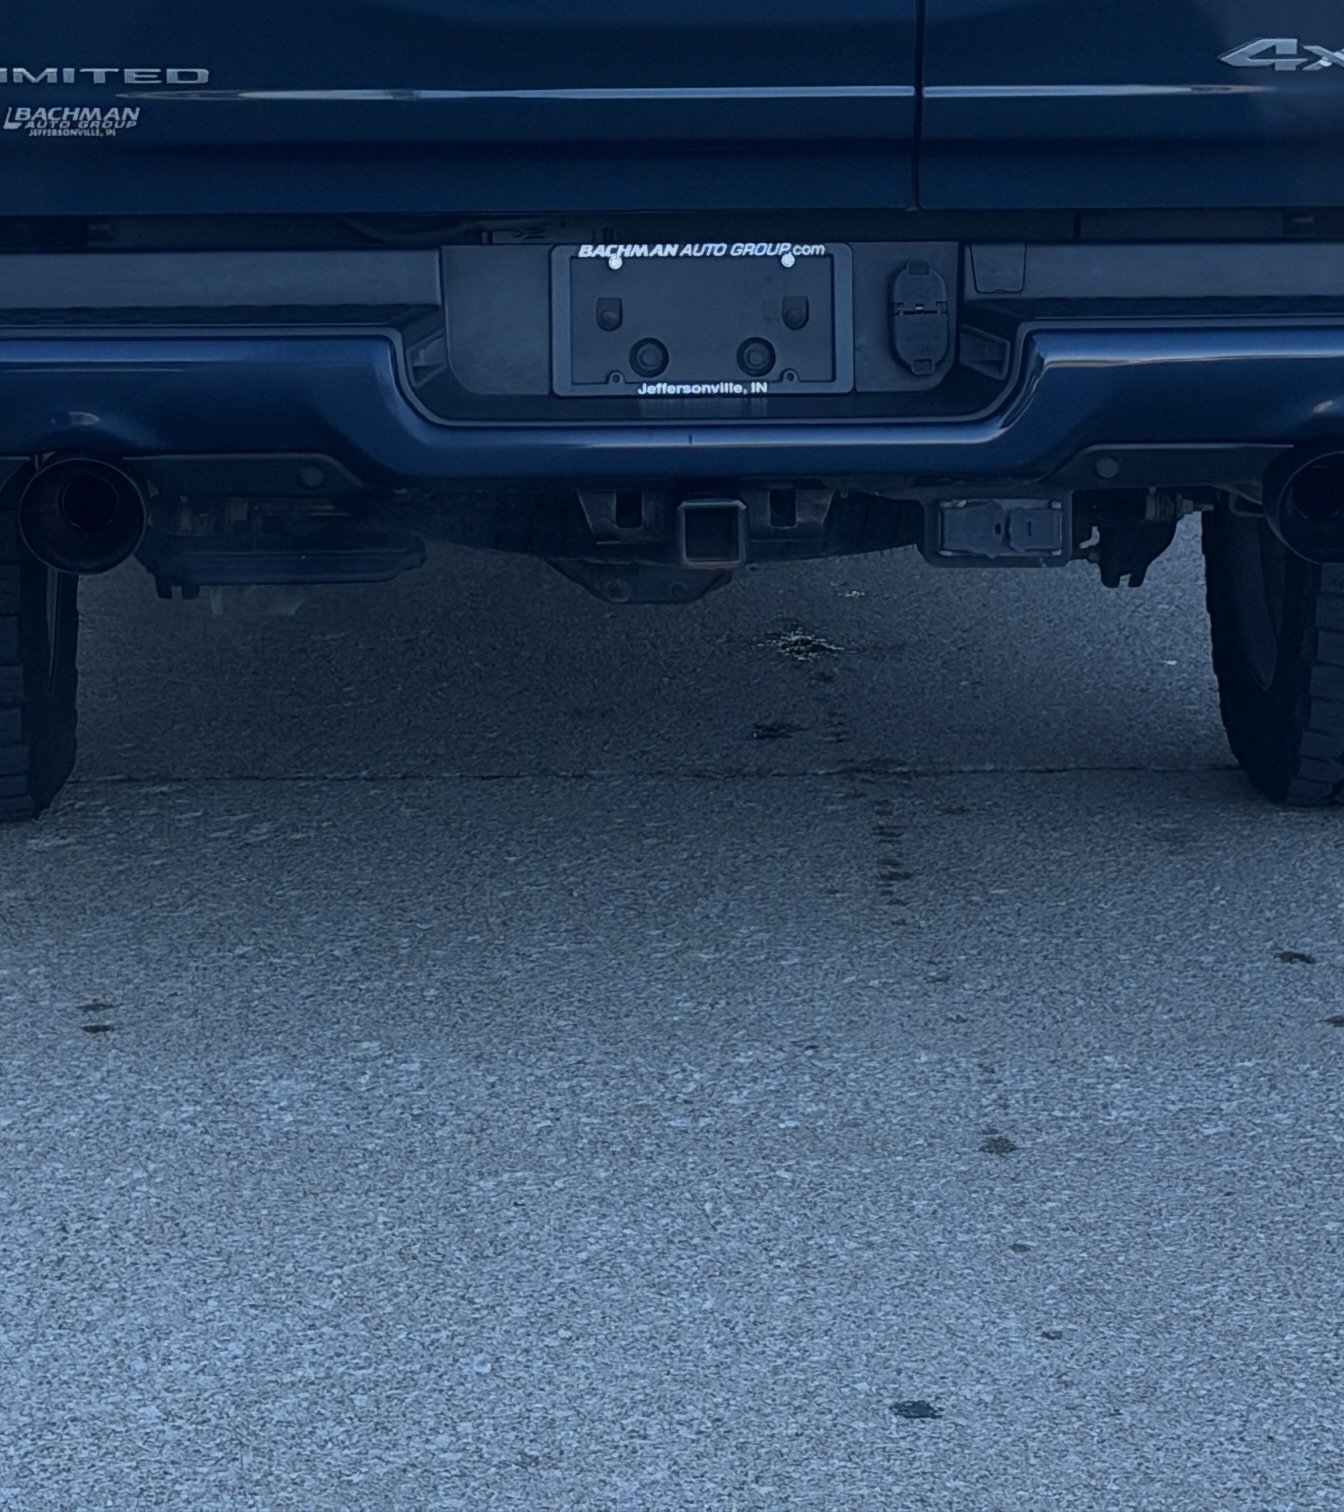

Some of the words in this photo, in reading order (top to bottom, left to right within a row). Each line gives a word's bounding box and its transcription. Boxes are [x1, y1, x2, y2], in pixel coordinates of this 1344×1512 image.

[14, 107, 141, 121] BACHMAN
[25, 120, 71, 129] AUTO
[77, 120, 138, 129] GROUP
[578, 244, 680, 258] BACHMAN
[679, 243, 727, 257] AUTO
[637, 382, 748, 395] Jeffersonville,
[751, 382, 768, 394] IN
